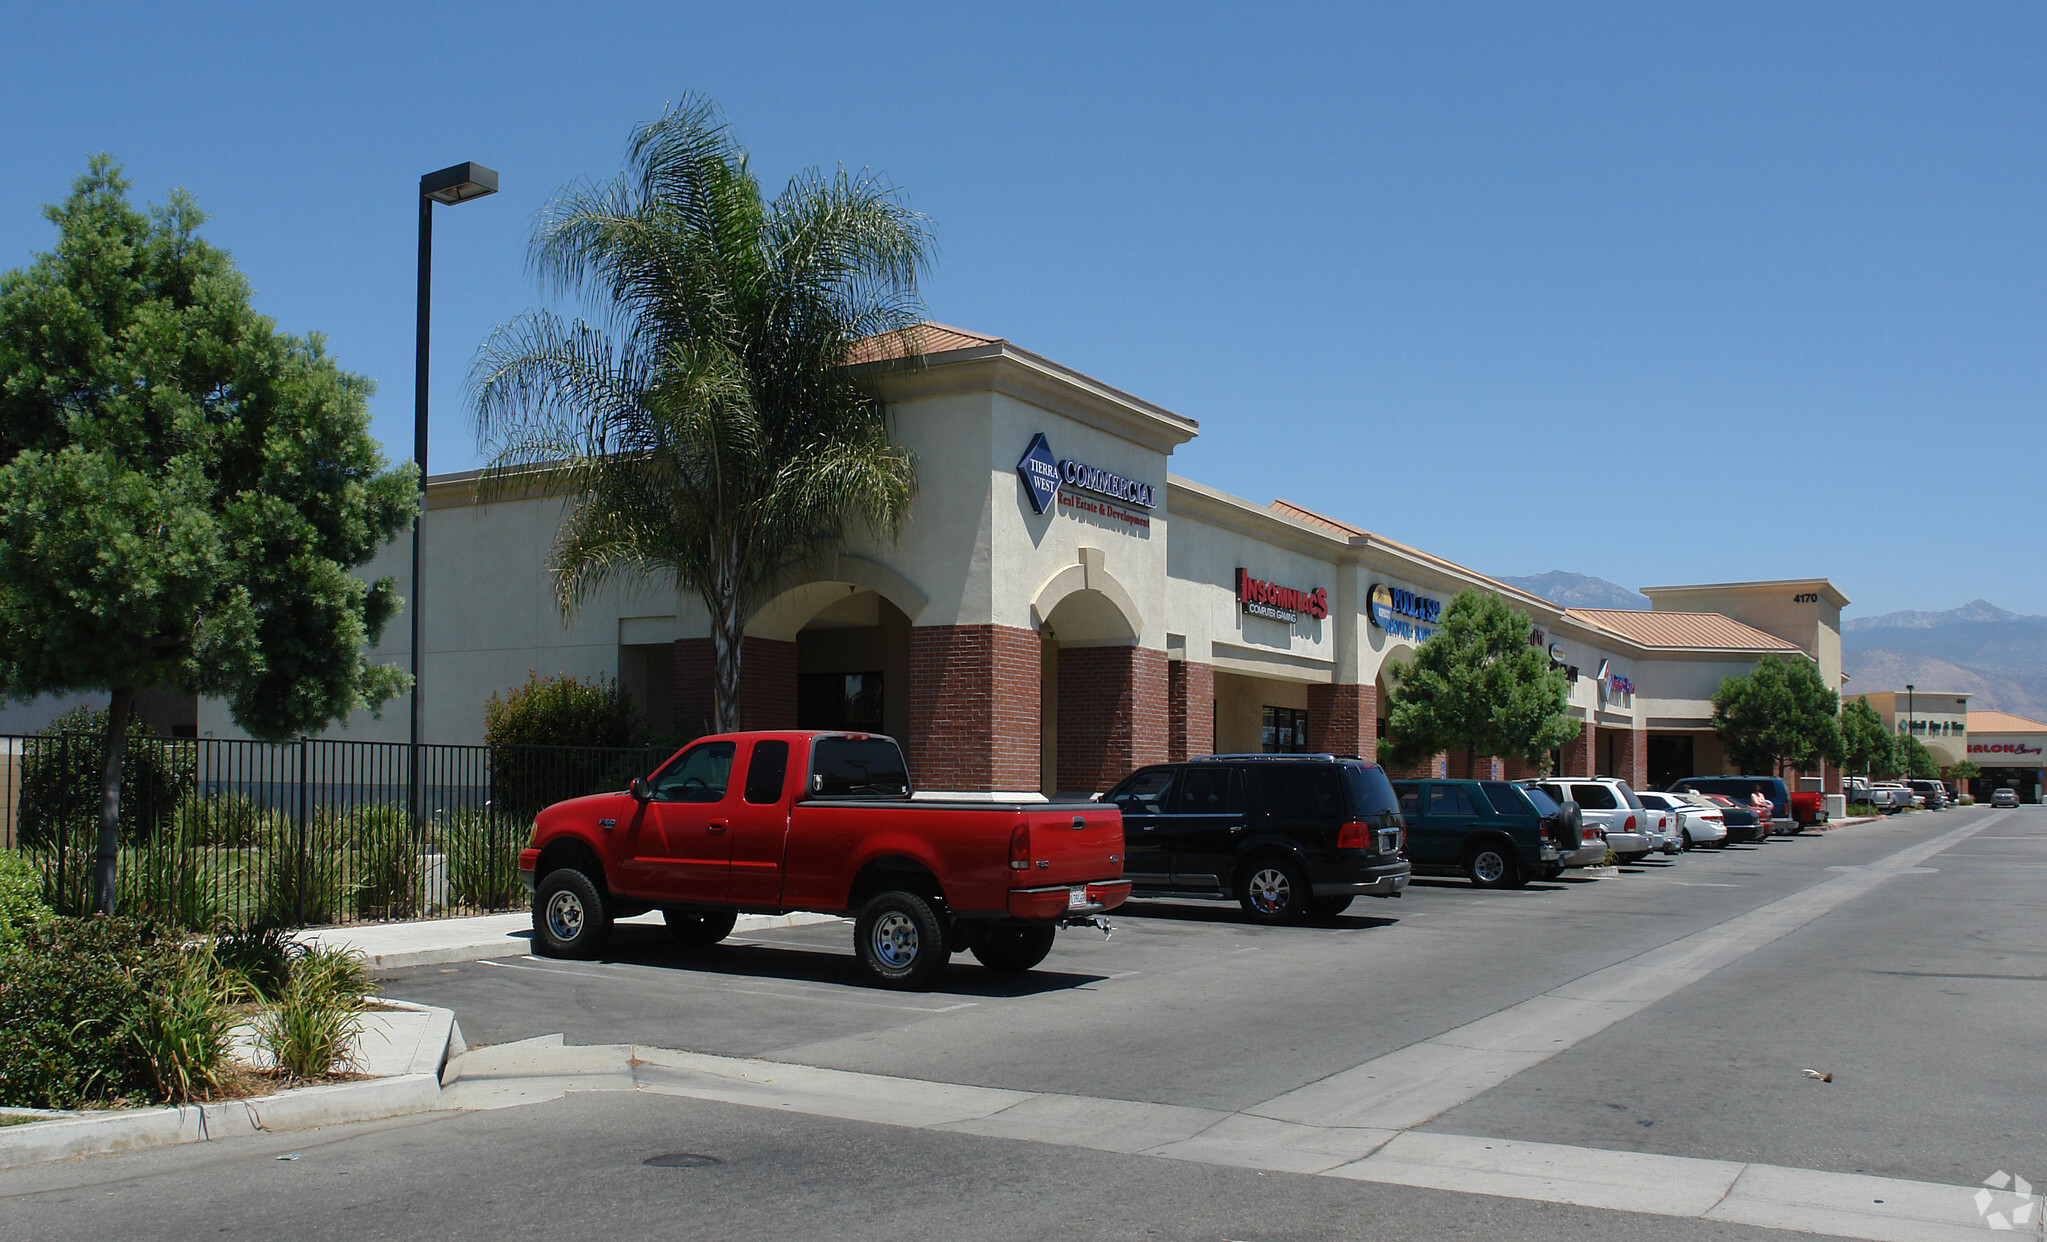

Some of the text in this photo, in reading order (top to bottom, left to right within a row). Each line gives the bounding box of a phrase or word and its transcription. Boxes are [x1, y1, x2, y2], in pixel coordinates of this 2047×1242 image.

[1030, 458, 1058, 479] TIERRA
[1034, 475, 1055, 493] WEST
[1063, 459, 1157, 509] COMMERCIAL
[1058, 491, 1150, 528] Real Estate & Development
[1392, 587, 1419, 618] POOL
[1420, 597, 1426, 620] &
[1793, 593, 1818, 604] 4170
[1249, 603, 1297, 623] COMPUTER GAMING
[1967, 744, 2015, 753] SALON
